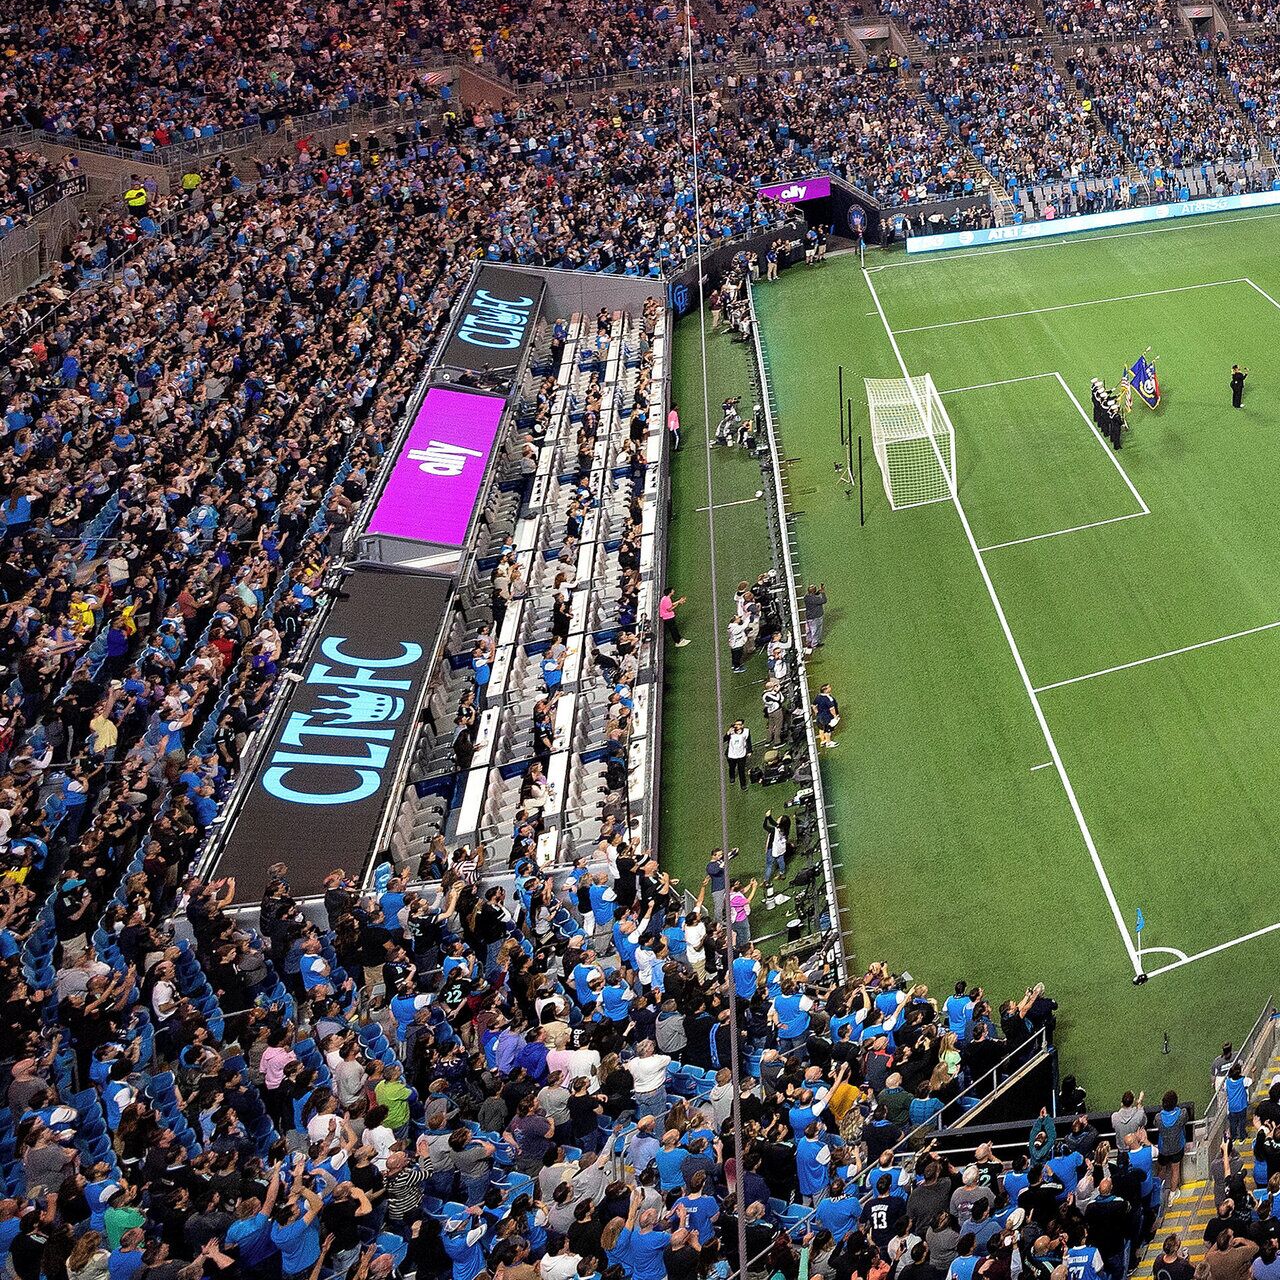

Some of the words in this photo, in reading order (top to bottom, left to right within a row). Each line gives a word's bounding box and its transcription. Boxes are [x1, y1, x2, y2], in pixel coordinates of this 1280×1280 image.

[780, 184, 808, 200] ally
[407, 438, 484, 477] ally
[871, 1211, 888, 1230] 13
